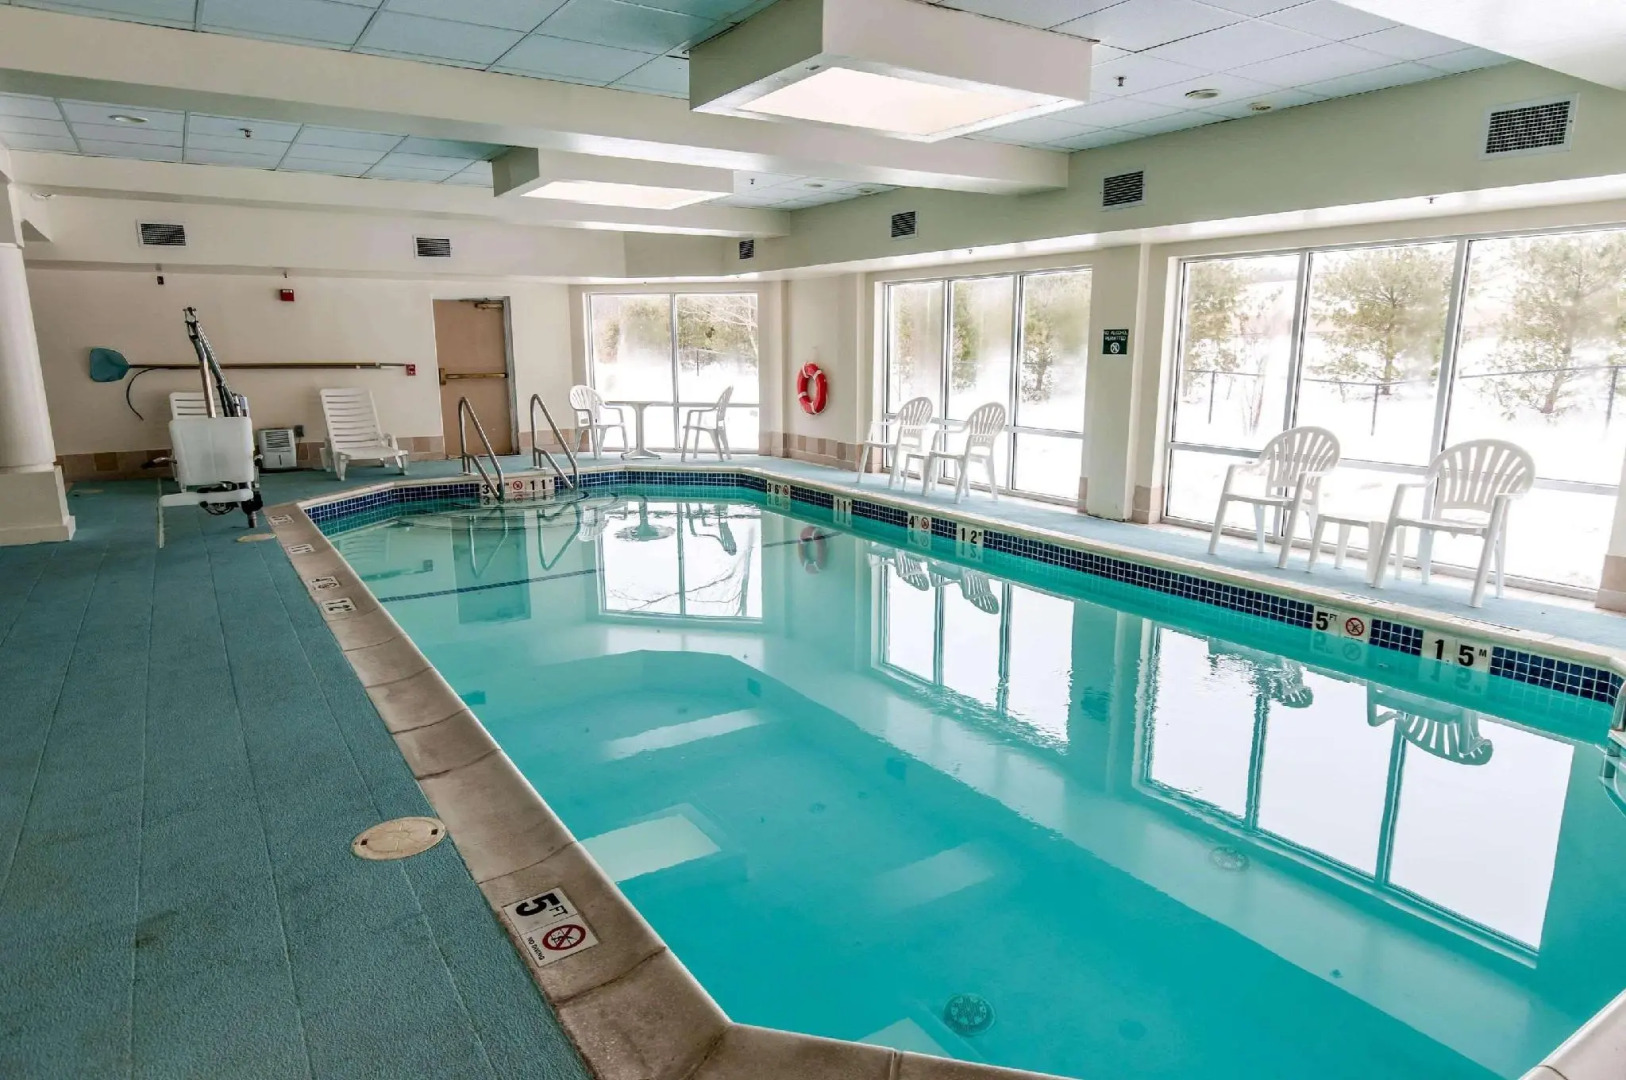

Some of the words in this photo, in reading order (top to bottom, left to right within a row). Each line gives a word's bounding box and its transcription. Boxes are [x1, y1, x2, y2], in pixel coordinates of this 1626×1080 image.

[1315, 611, 1329, 631] 5
[1329, 614, 1338, 622] FT
[1478, 648, 1488, 658] M
[515, 893, 560, 916] 5
[549, 905, 568, 918] FT
